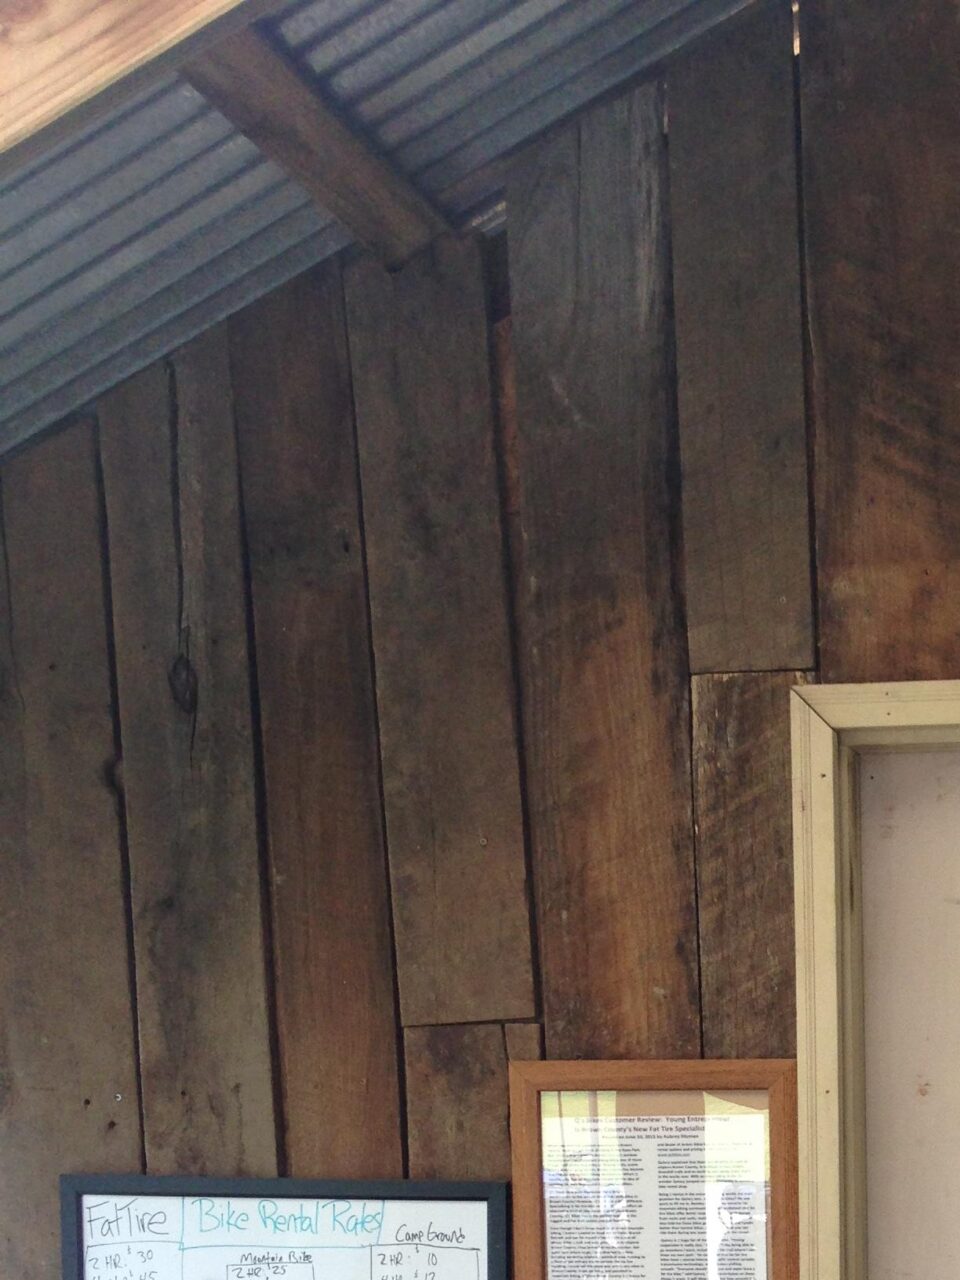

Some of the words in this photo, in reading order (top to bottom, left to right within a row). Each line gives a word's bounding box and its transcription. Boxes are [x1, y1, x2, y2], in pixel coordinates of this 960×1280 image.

[665, 1116, 686, 1124] Young
[675, 1125, 705, 1133] Specialist
[191, 1198, 249, 1233] Bike
[258, 1199, 320, 1234] Rental
[322, 1200, 381, 1235] Rates
